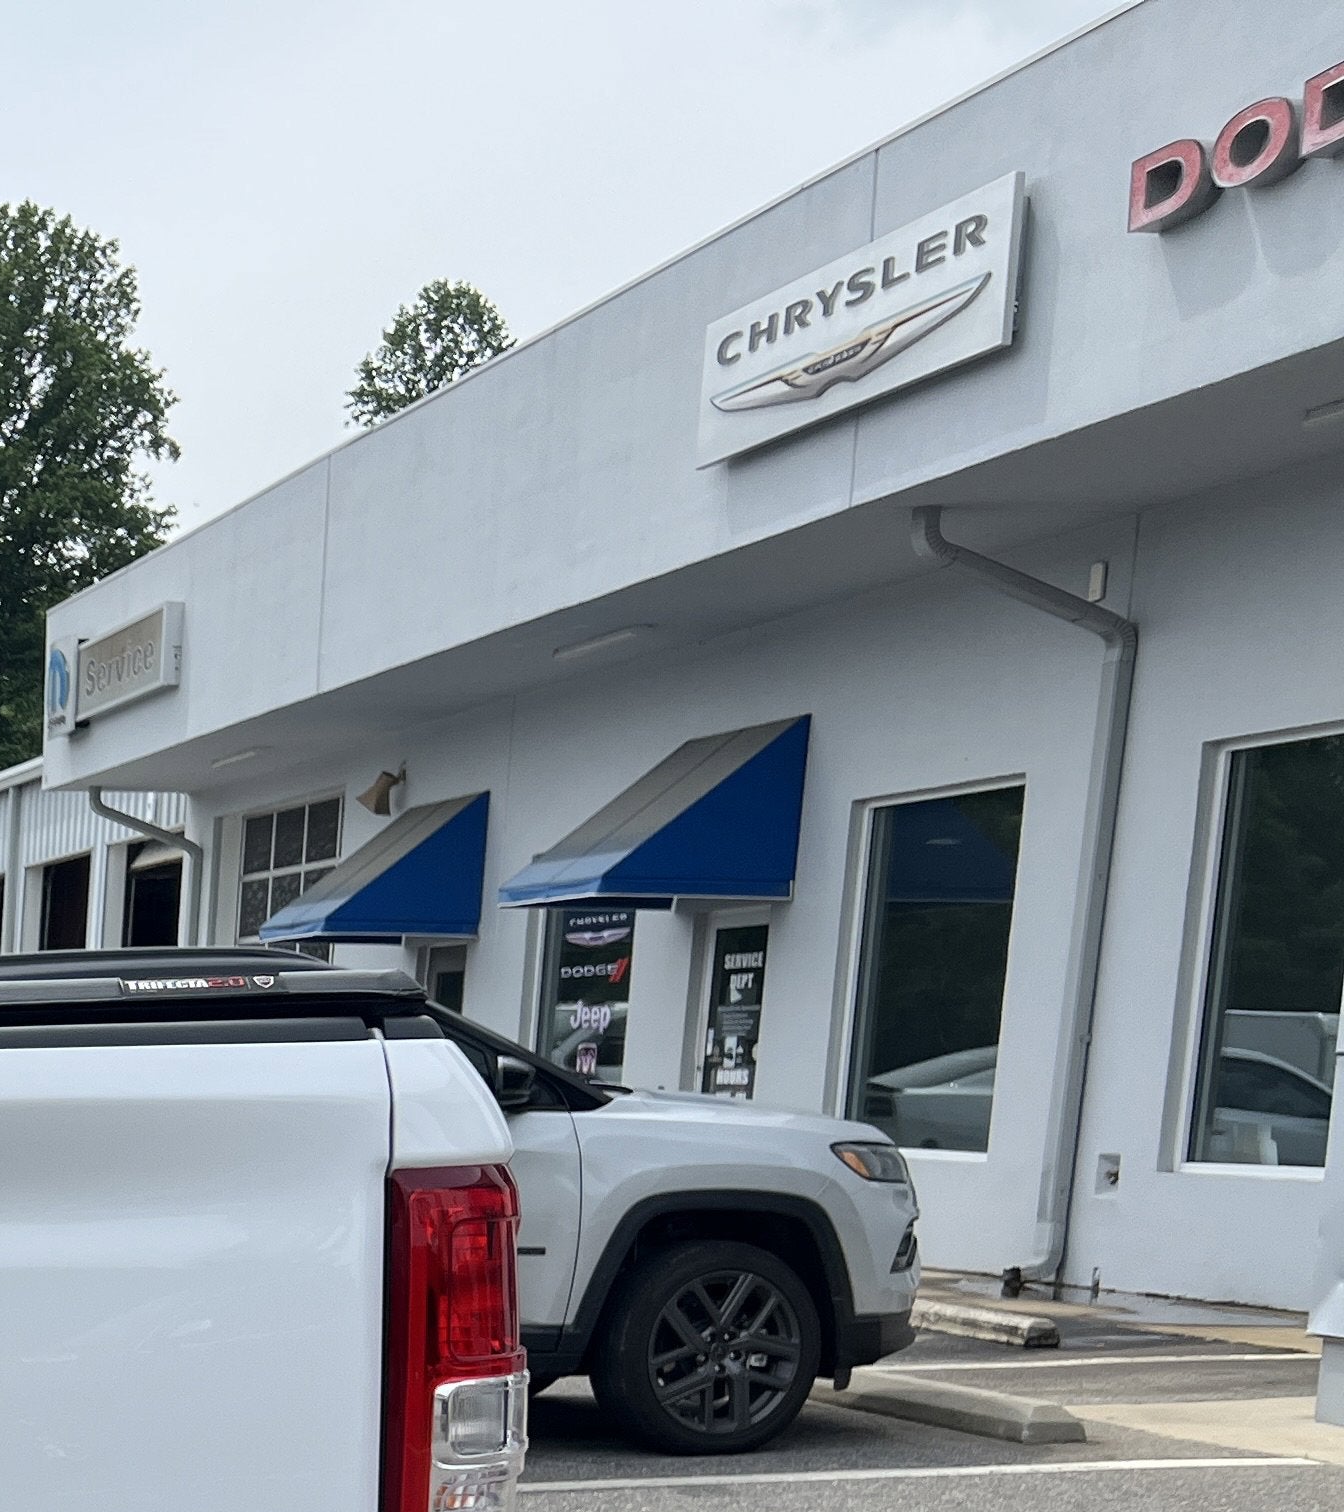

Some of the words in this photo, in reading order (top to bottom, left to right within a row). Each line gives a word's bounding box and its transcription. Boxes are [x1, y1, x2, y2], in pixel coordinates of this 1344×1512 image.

[716, 213, 989, 367] CHRYSLER
[85, 641, 154, 697] Service
[561, 963, 618, 979] DODGE
[724, 951, 764, 970] SERVICE
[570, 999, 611, 1035] Jeep
